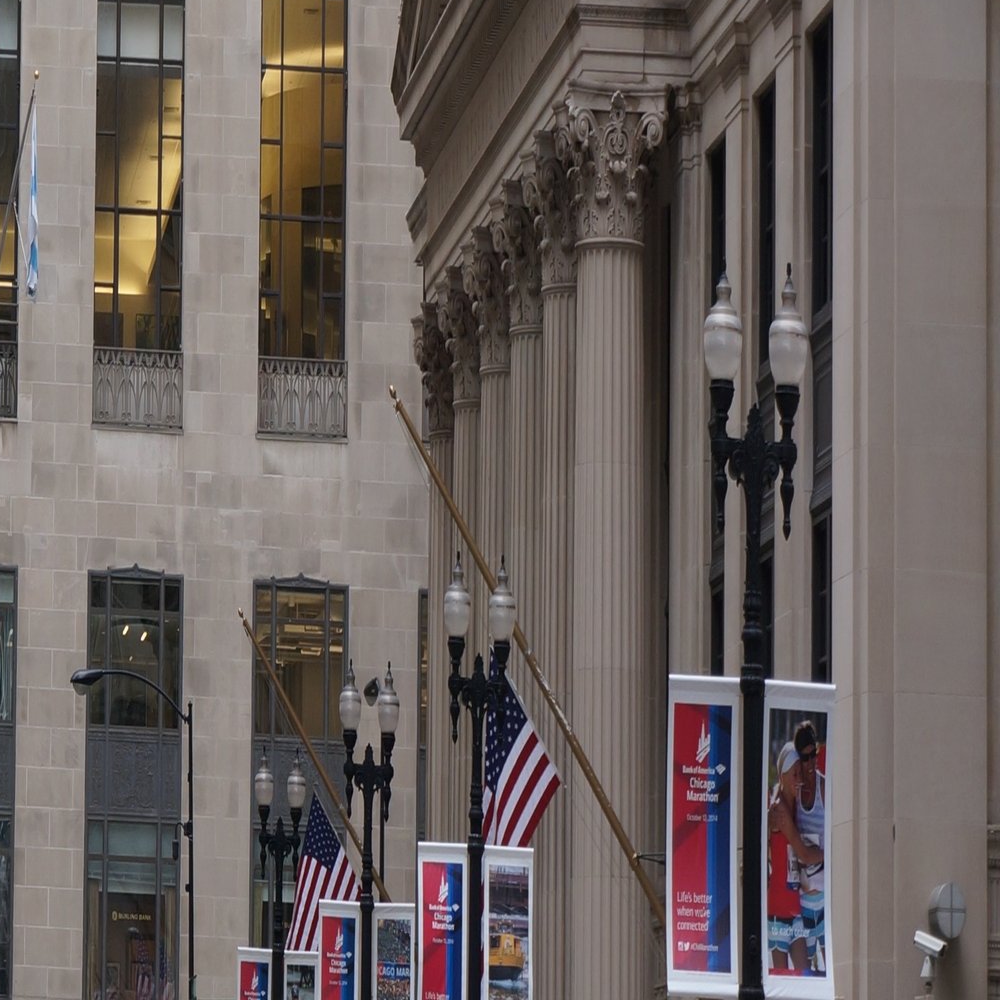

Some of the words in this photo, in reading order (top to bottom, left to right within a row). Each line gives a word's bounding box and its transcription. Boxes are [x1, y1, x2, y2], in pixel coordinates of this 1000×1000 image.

[690, 777, 715, 791] Chicago
[686, 790, 718, 803] Marathon
[677, 891, 692, 903] Life's
[693, 892, 712, 904] better
[677, 906, 693, 917] when
[677, 921, 709, 932] connected
